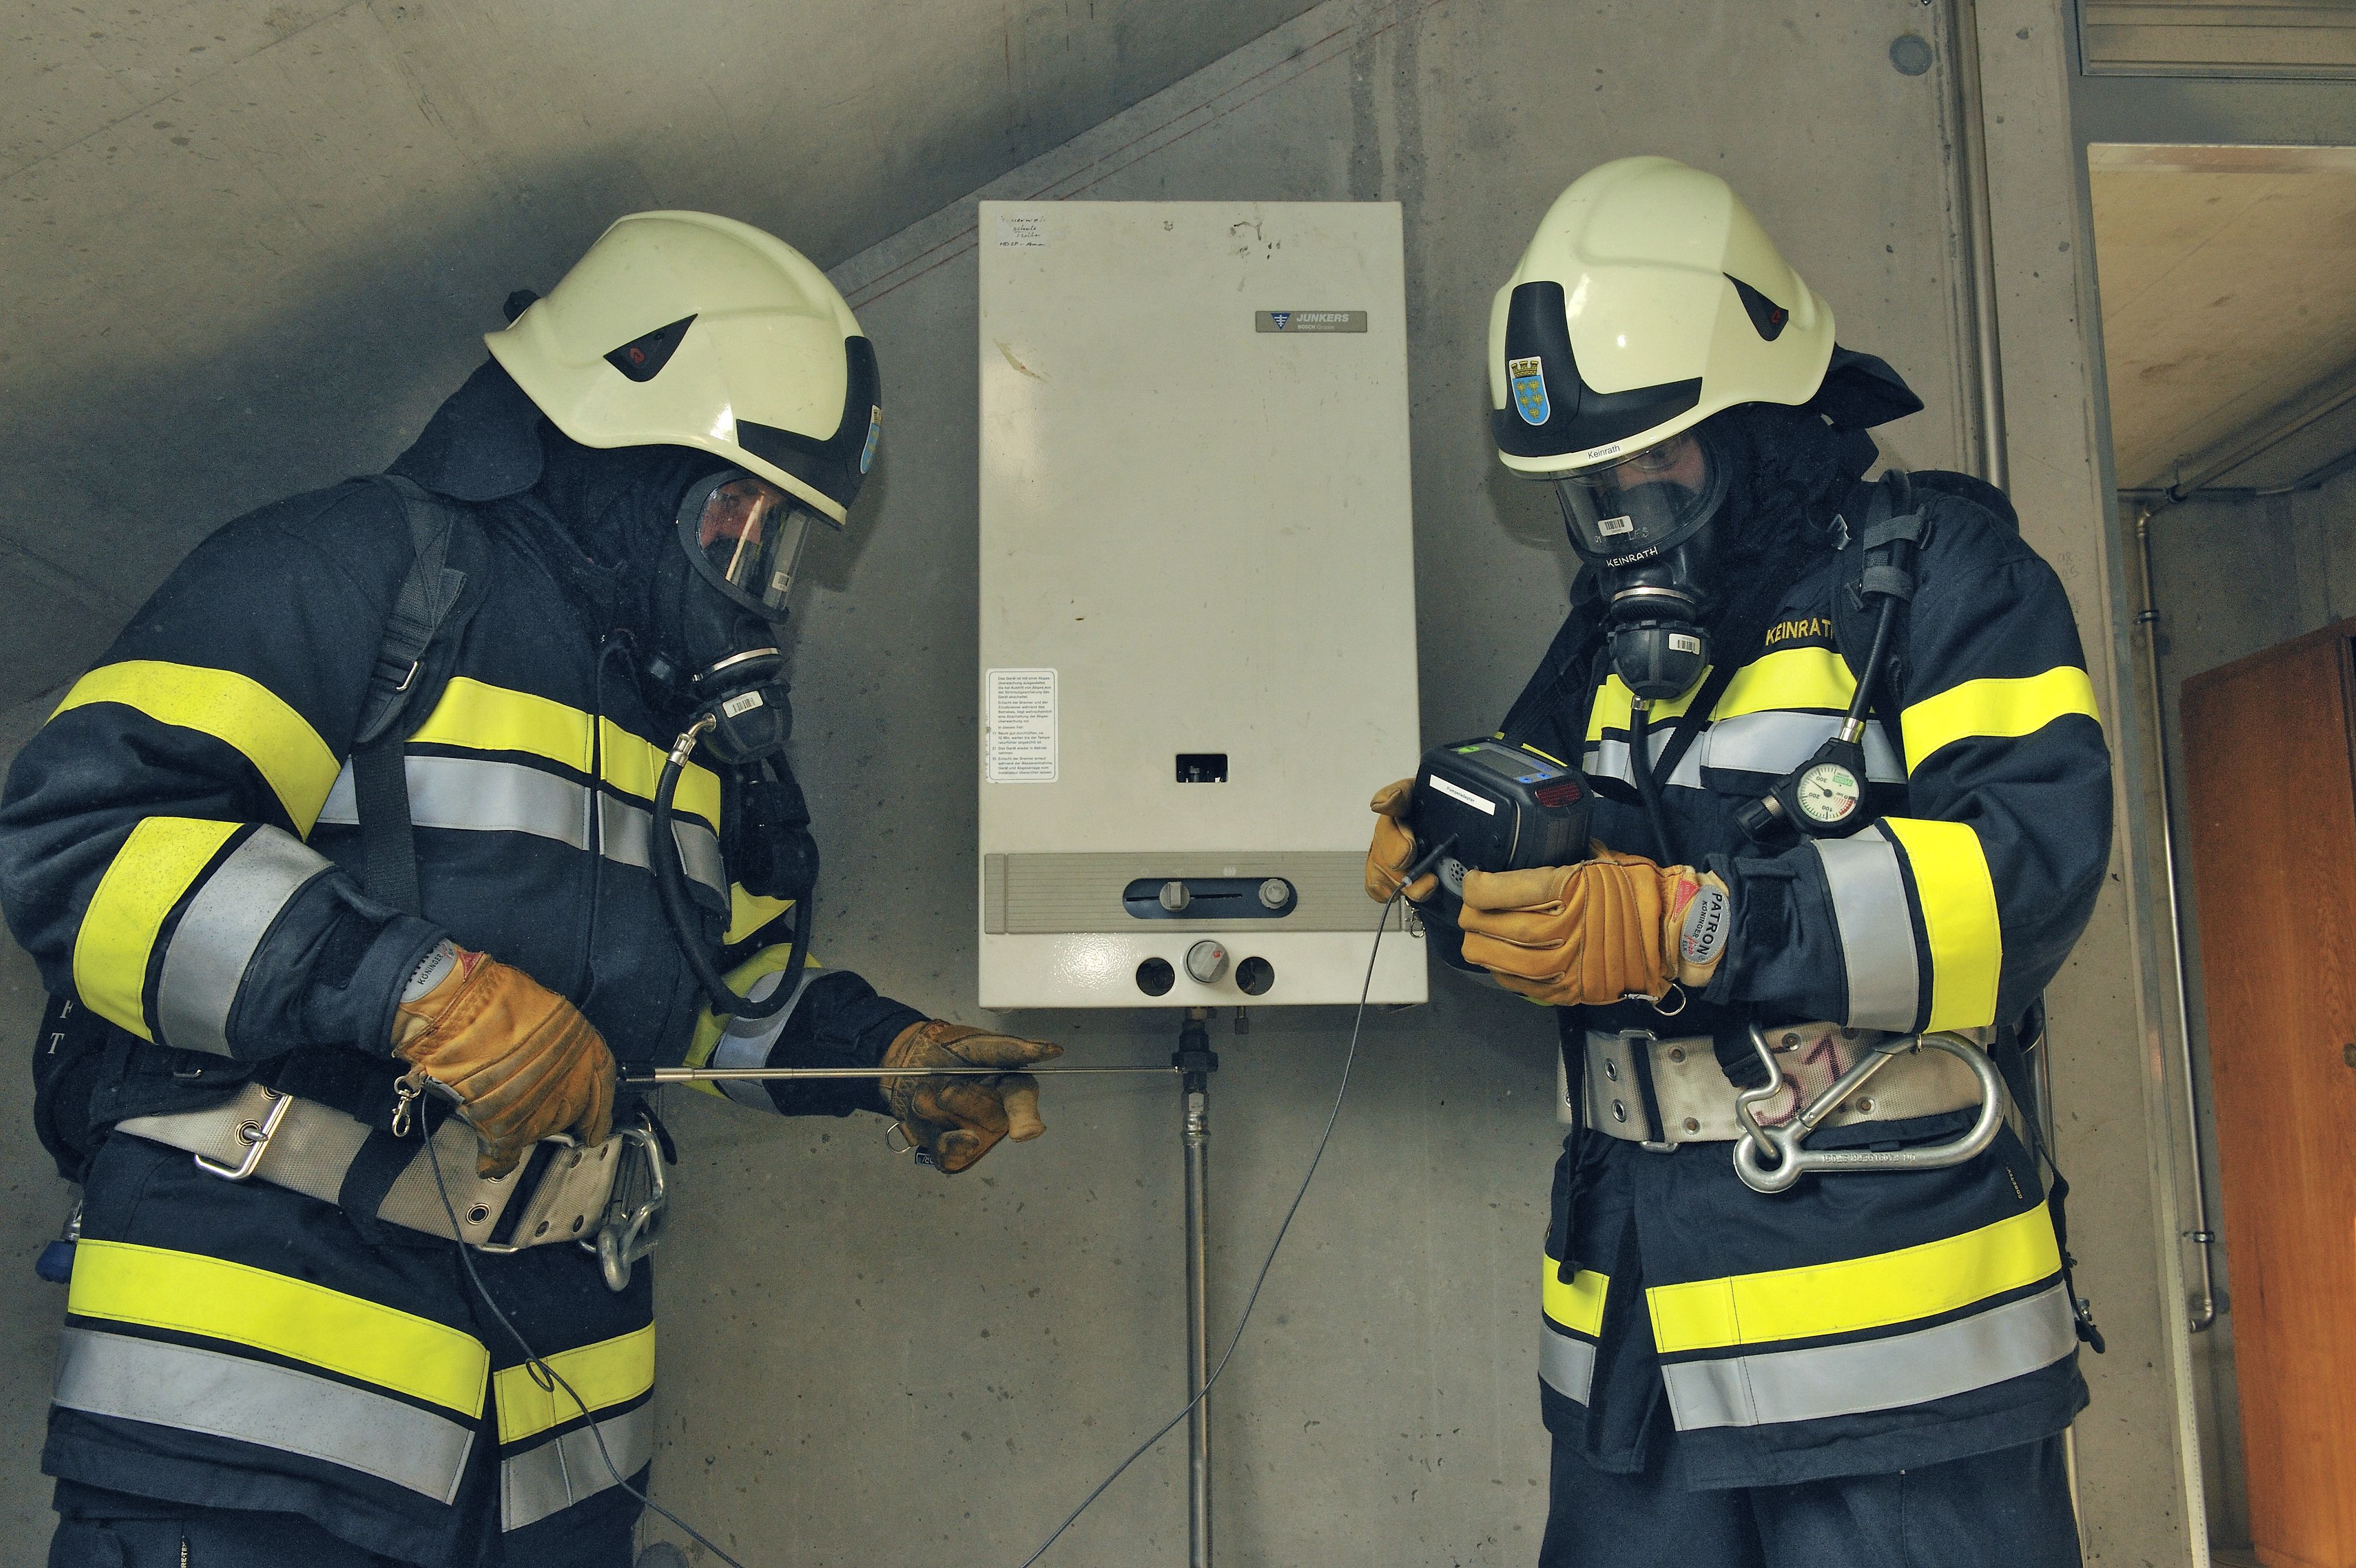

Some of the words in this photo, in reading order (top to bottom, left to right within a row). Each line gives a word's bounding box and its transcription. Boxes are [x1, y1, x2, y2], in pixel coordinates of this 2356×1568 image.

[1296, 313, 1349, 322] JUNKERS
[1587, 445, 1620, 459] Keinrath
[1606, 545, 1659, 568] KEINRATH
[1696, 892, 1723, 955] PATRON
